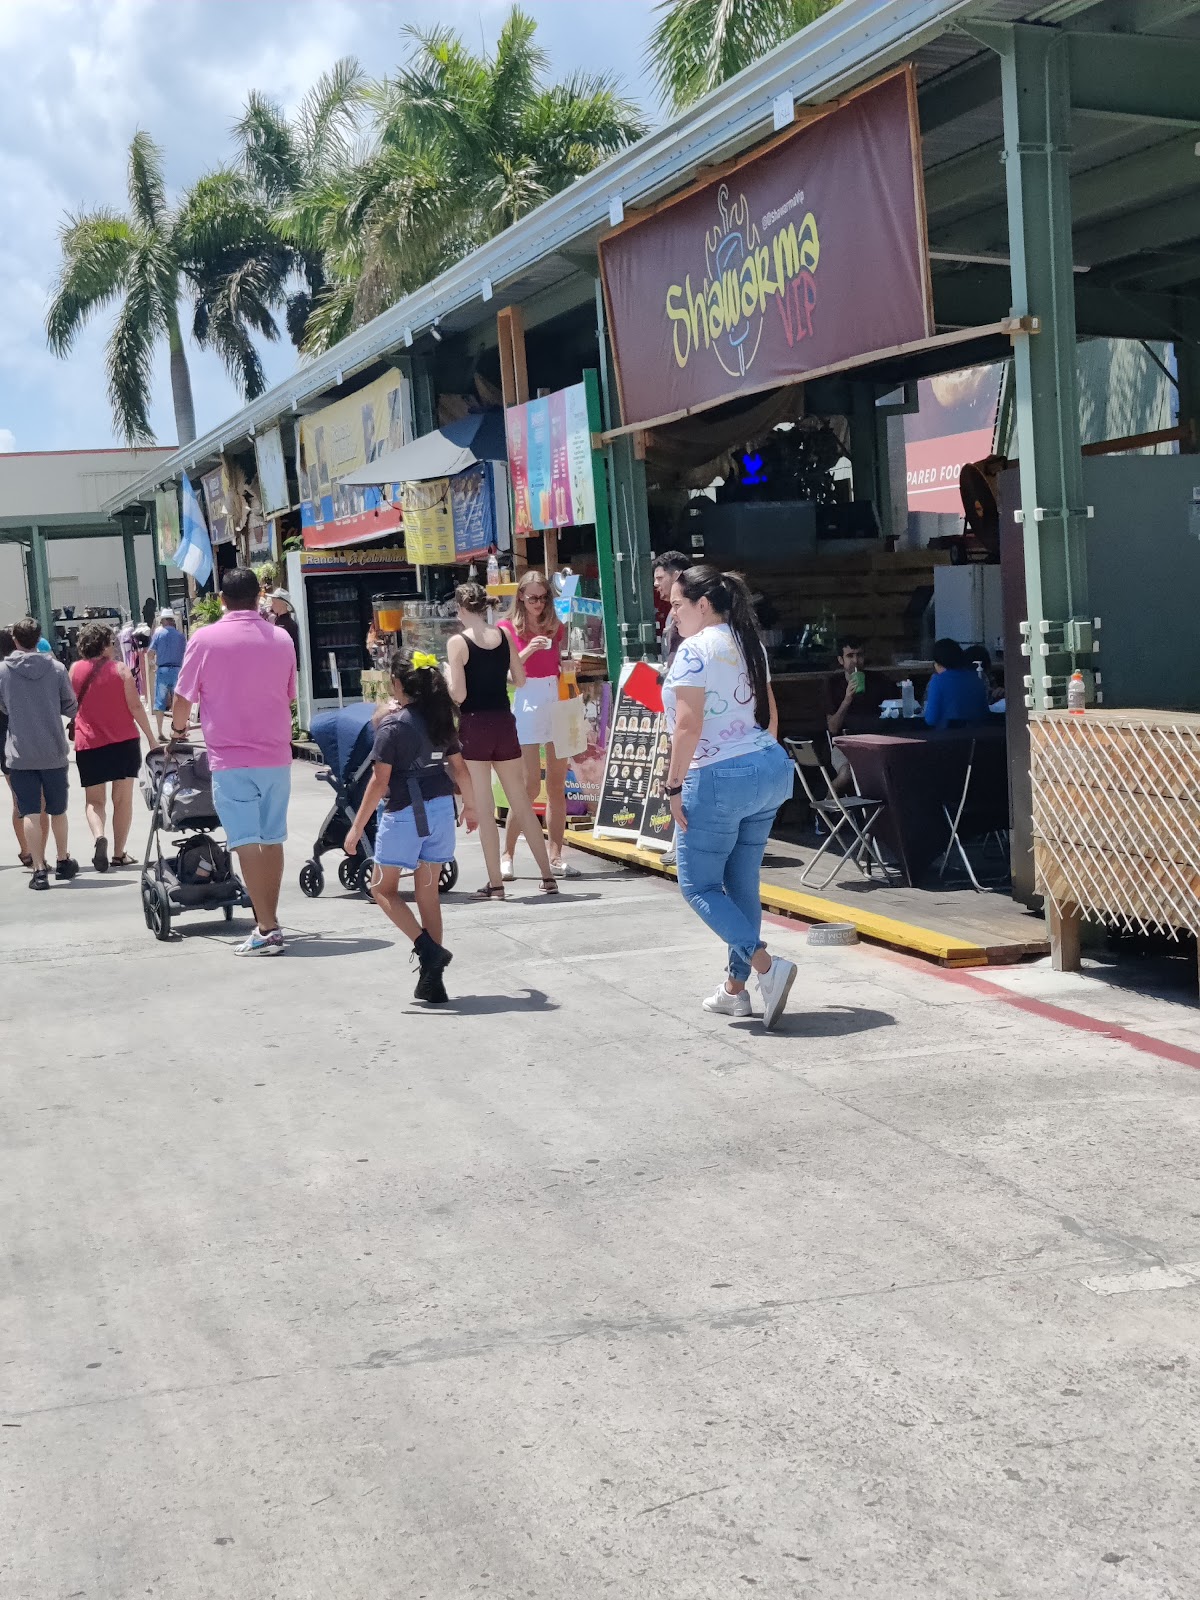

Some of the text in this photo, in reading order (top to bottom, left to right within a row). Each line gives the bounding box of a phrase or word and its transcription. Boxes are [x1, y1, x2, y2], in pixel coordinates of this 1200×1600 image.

[776, 271, 817, 348] VIP
[940, 463, 966, 480] FOO
[360, 551, 407, 566] Colombian
[564, 780, 600, 790] Cholados
